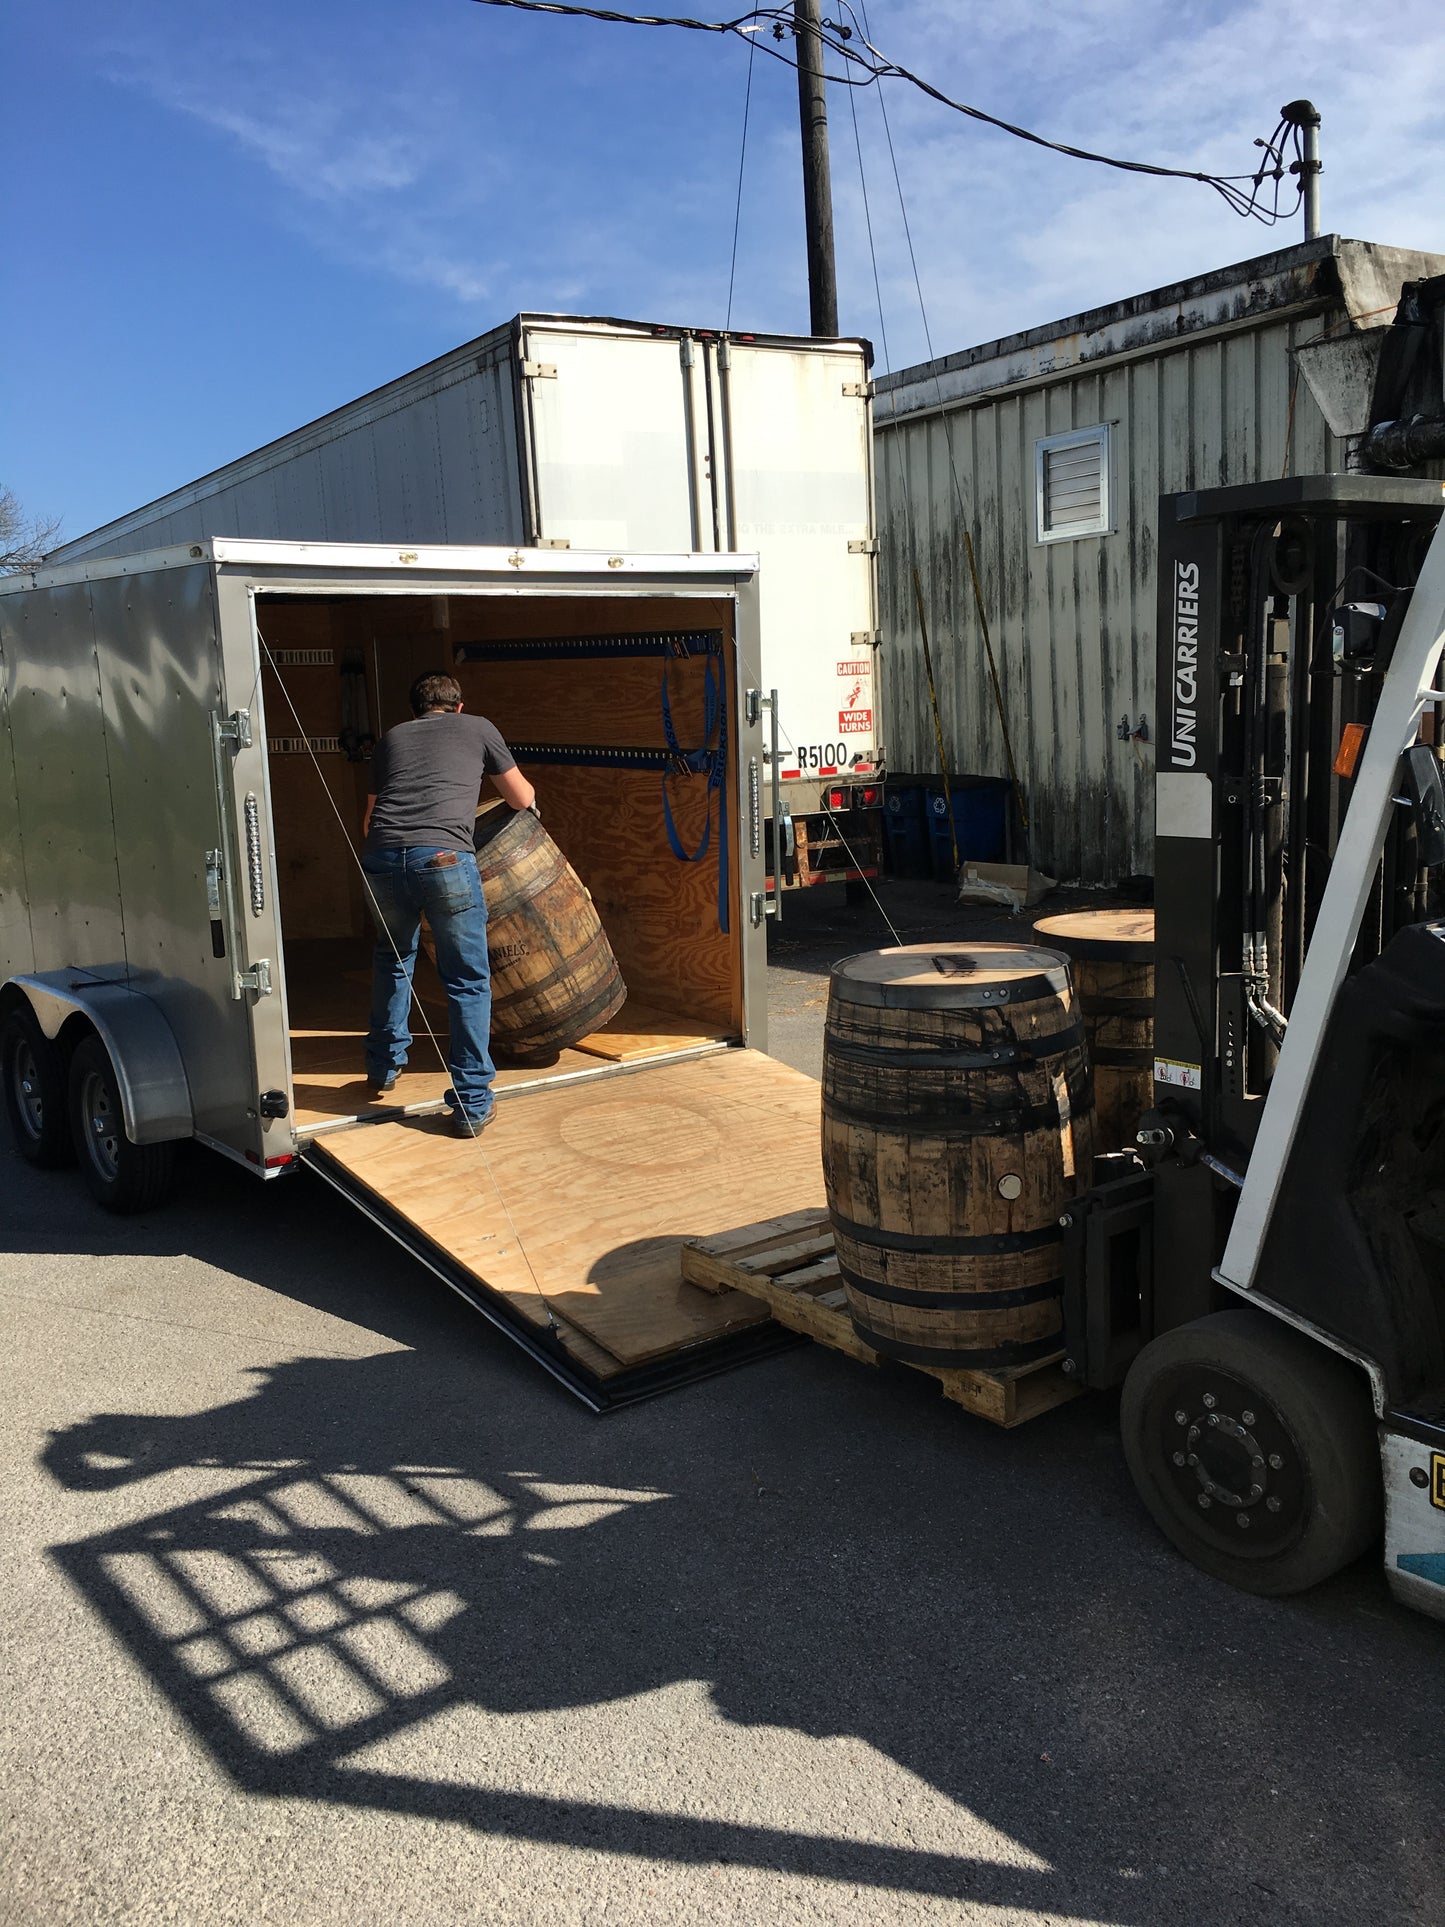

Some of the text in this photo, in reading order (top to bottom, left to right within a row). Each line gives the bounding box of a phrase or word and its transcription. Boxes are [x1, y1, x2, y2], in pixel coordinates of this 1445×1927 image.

[837, 662, 870, 675] CAUTION
[843, 711, 868, 722] WIDE
[840, 721, 871, 732] TURNS
[712, 703, 726, 787] ERICKSON
[798, 742, 847, 769] R5100
